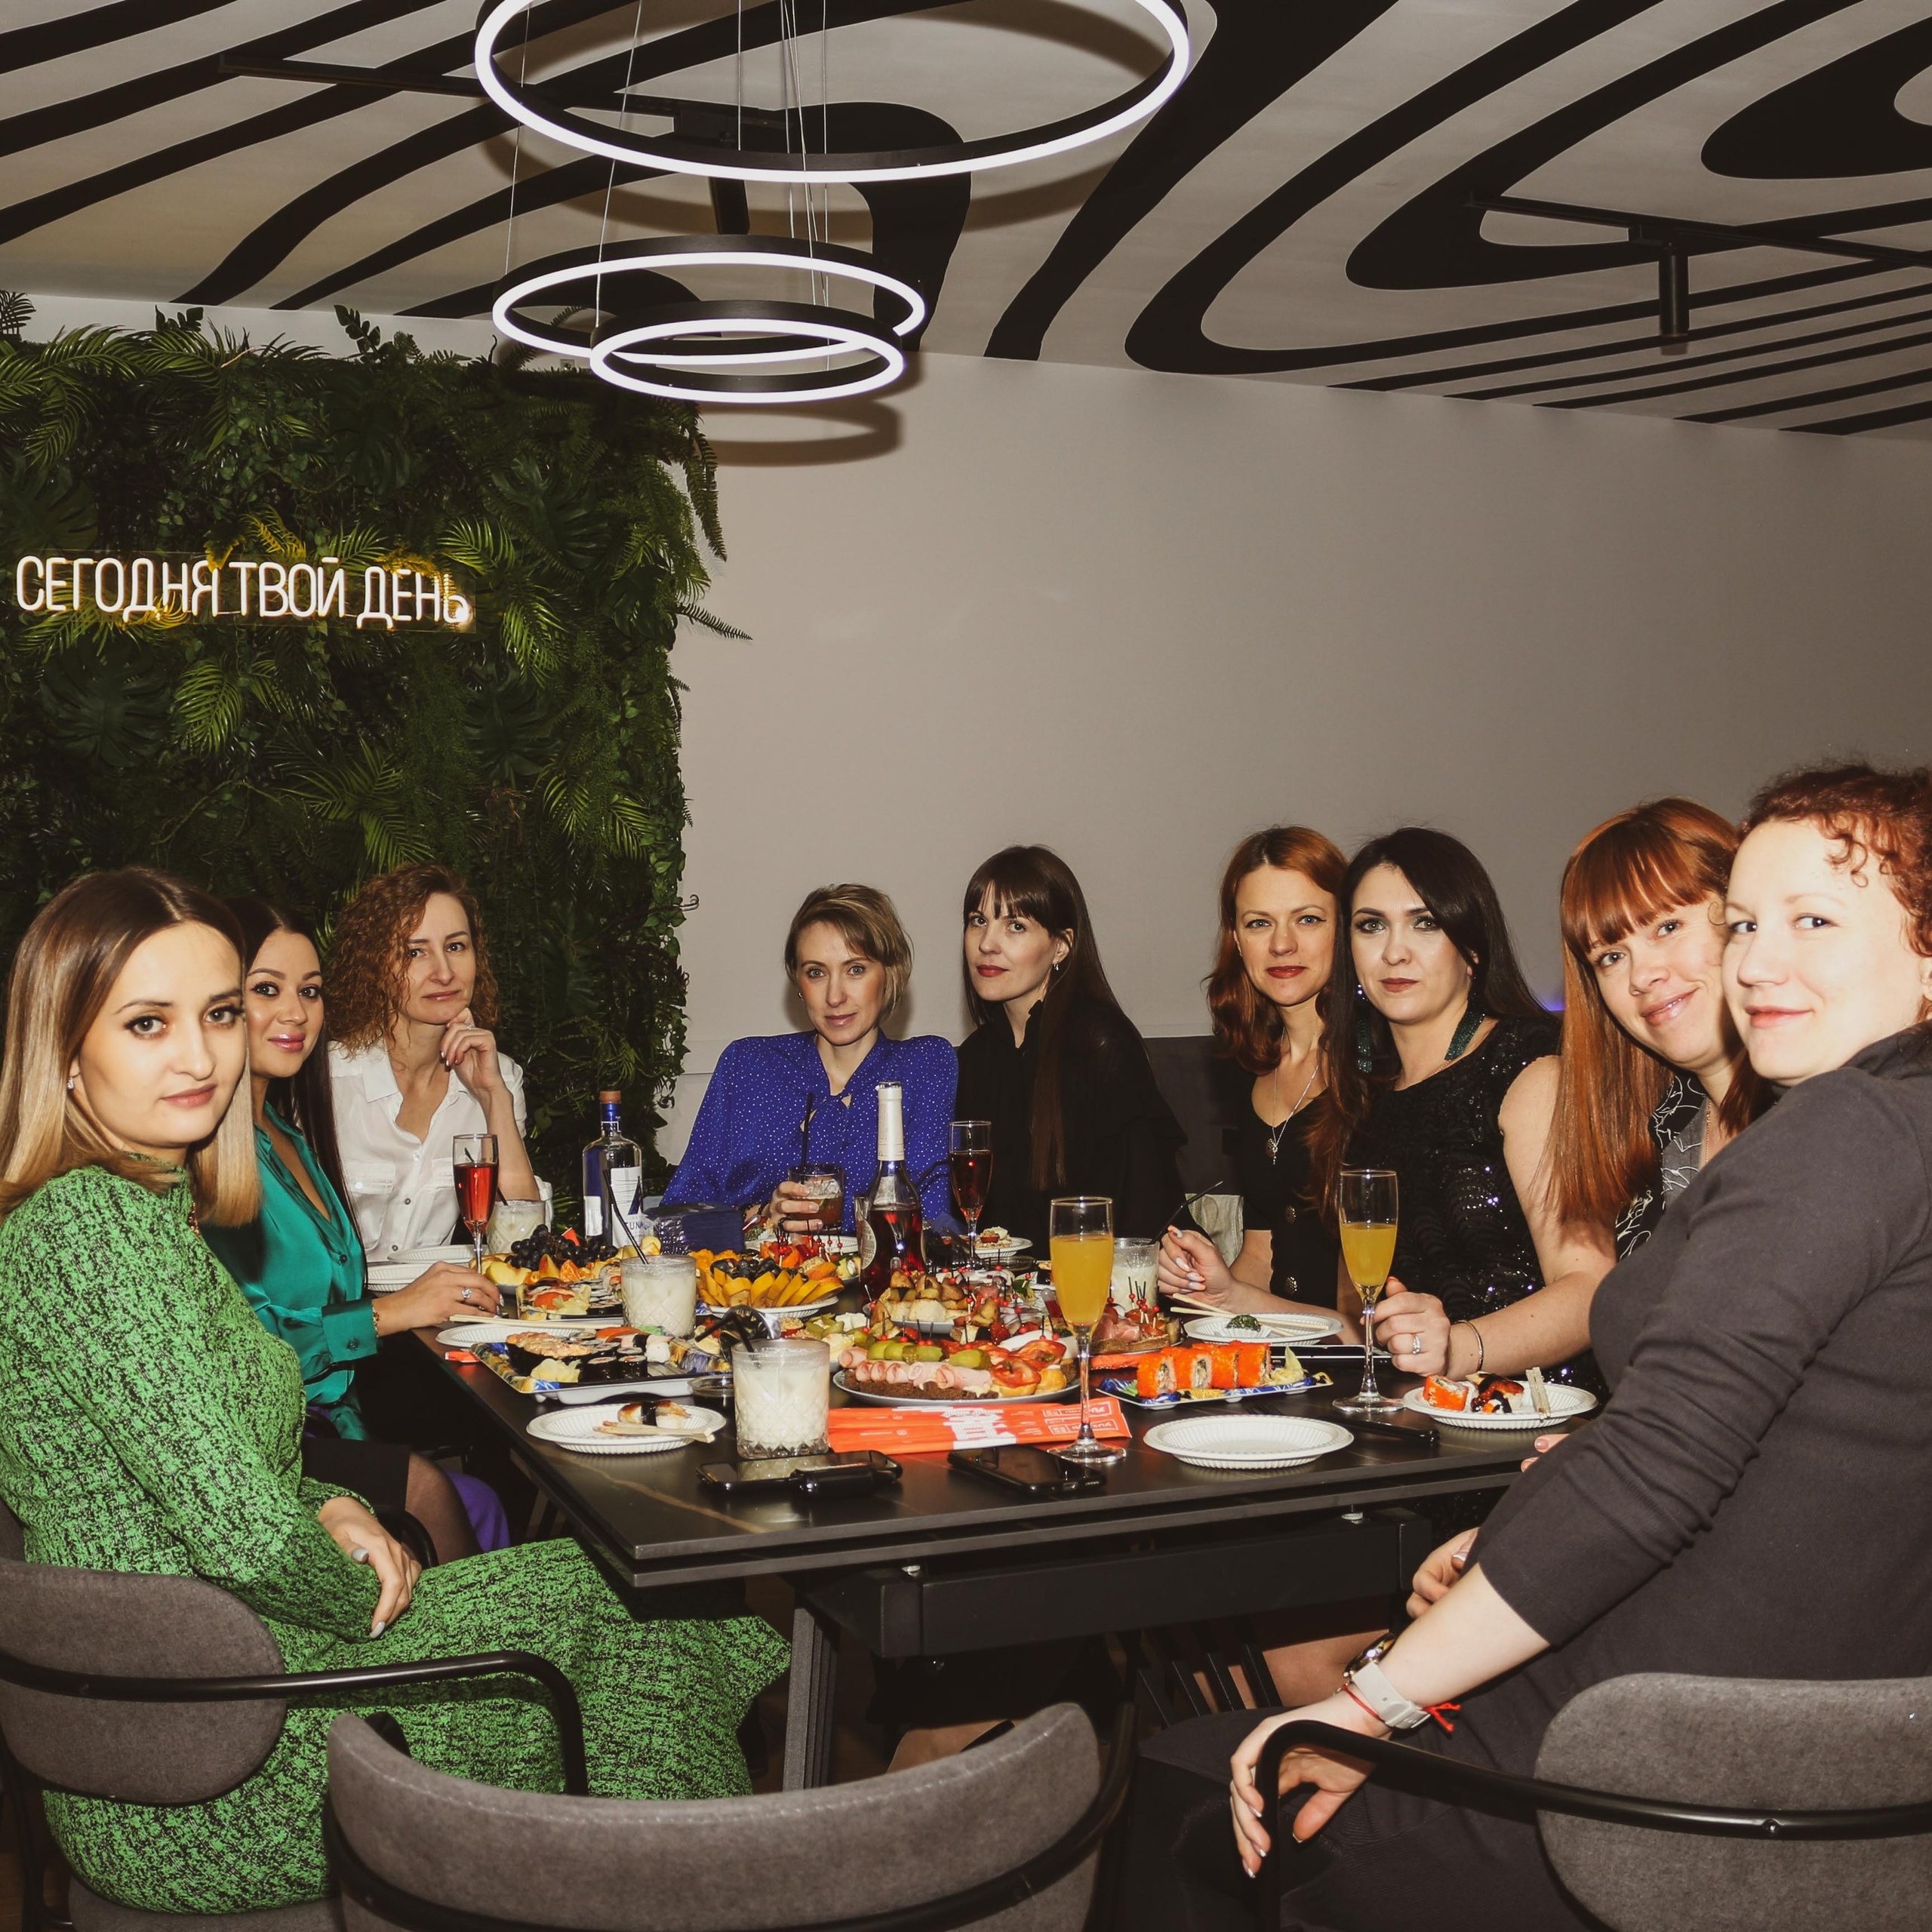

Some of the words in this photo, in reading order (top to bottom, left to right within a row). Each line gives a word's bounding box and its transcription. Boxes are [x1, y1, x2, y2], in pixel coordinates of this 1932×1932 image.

[16, 555, 219, 623] СЕГОДНЯ
[228, 556, 346, 618] ТВОЙ
[355, 565, 469, 629] ДЕНЬ
